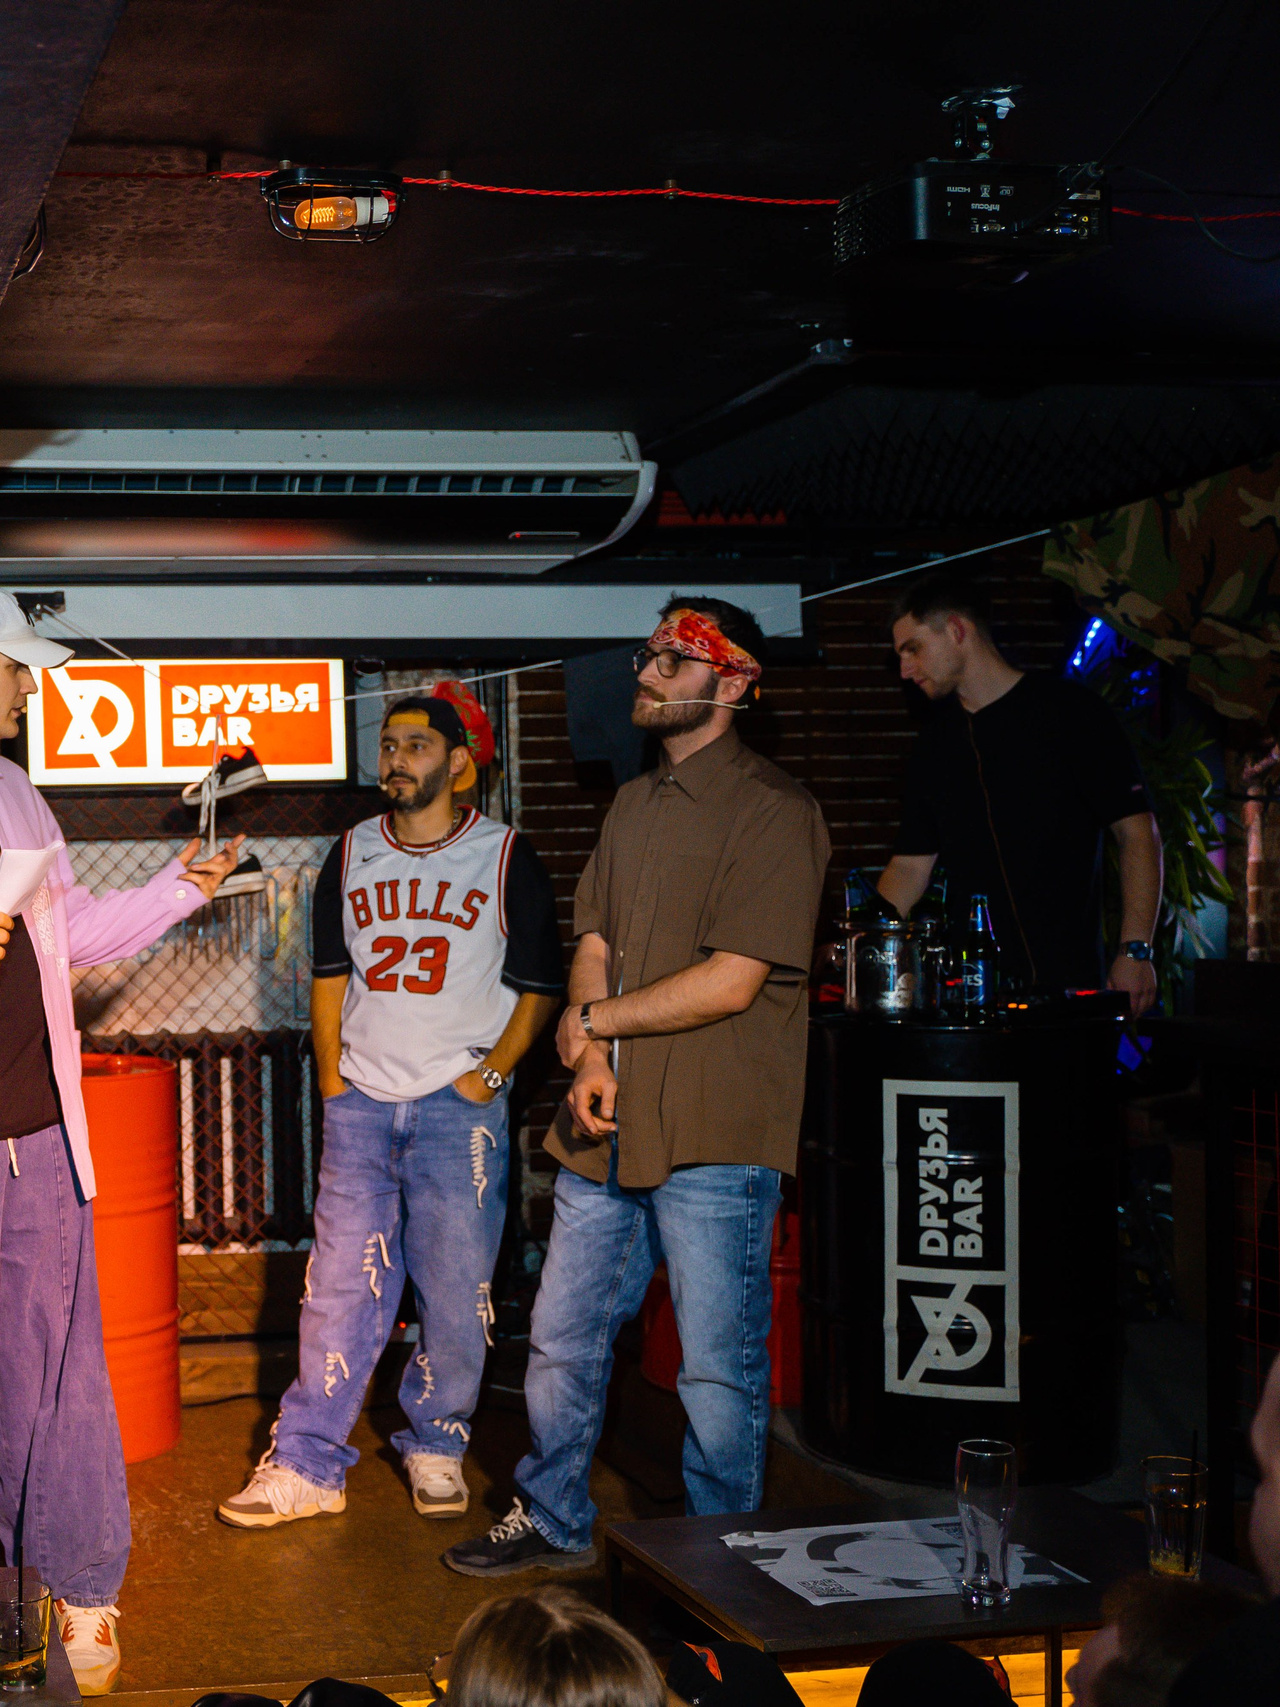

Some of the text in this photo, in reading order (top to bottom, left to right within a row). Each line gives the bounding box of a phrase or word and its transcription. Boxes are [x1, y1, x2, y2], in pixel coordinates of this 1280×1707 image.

[172, 716, 255, 747] BAR
[348, 879, 488, 931] BULLS
[366, 936, 450, 995] 23
[953, 1175, 983, 1258] BAR
